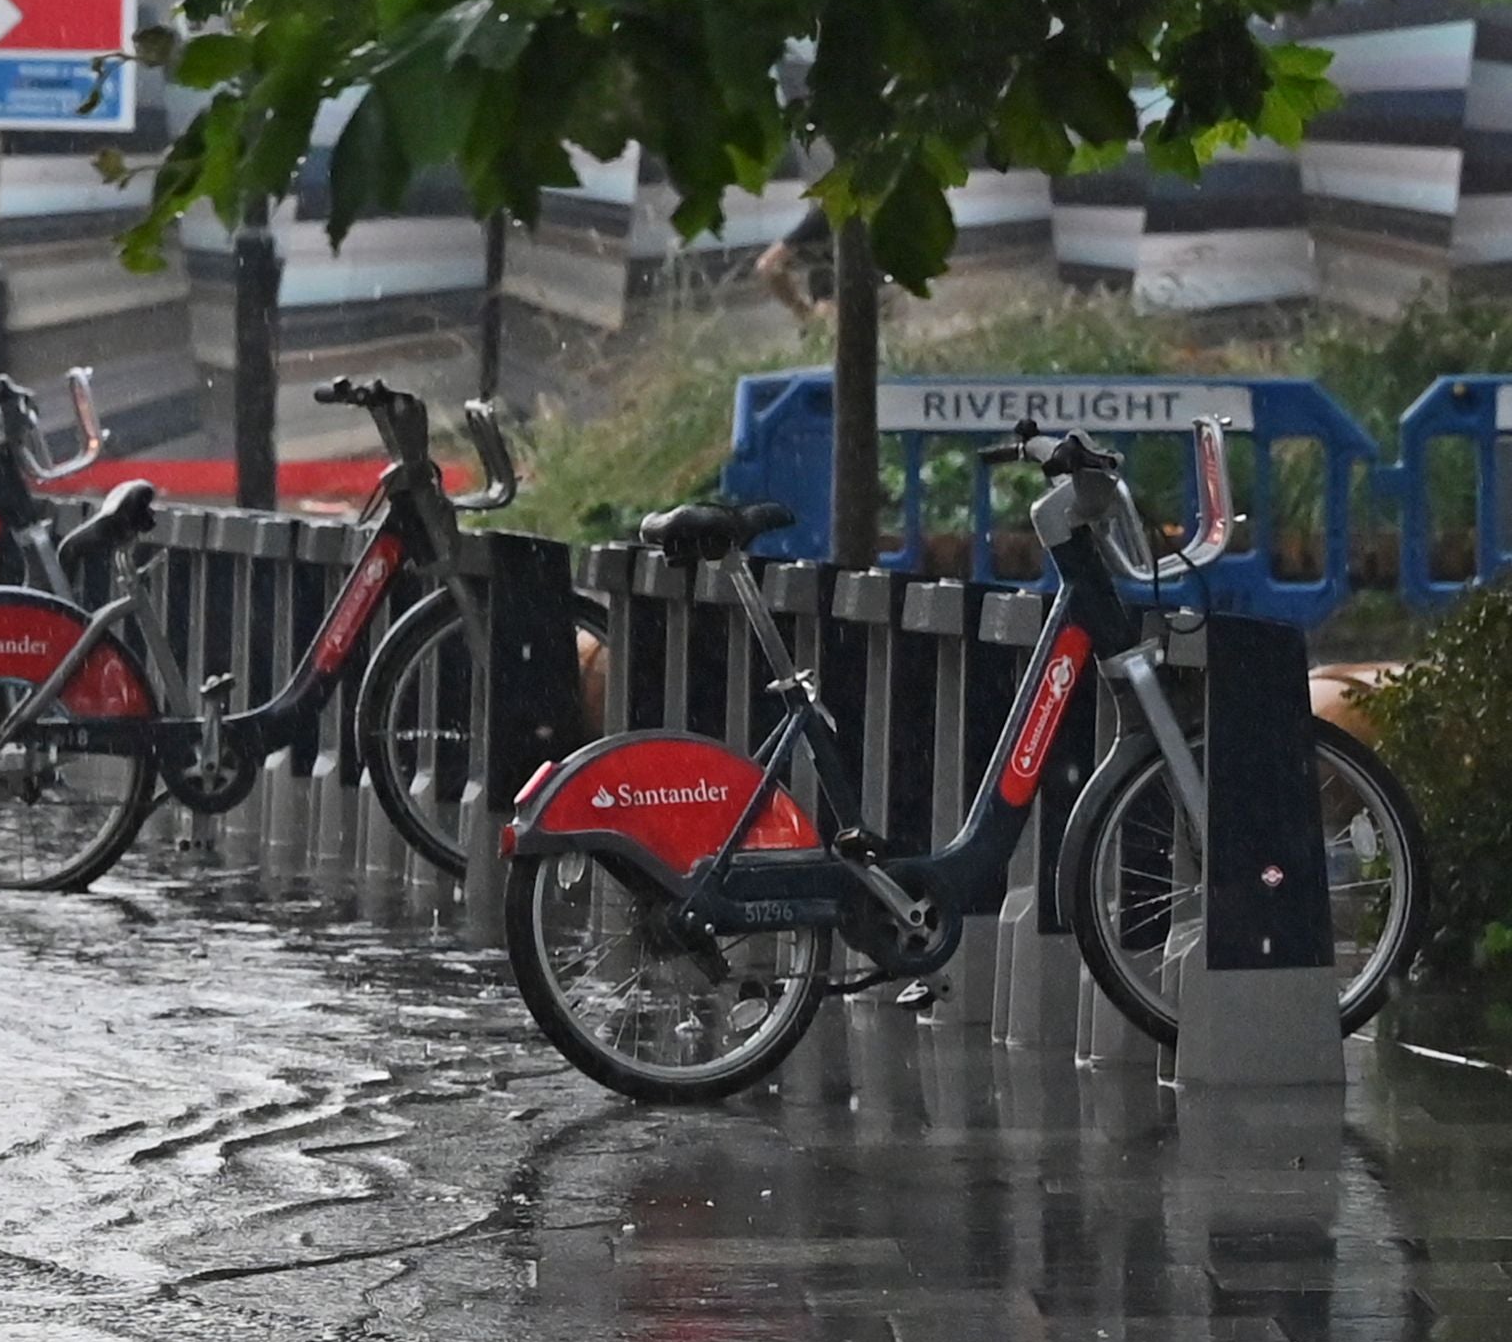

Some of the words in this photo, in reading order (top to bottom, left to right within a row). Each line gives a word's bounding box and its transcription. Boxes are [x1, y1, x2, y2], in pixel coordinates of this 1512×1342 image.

[922, 391, 1180, 422] RIVERLIGHT
[1025, 694, 1056, 757] Santander
[617, 778, 729, 807] Santander
[744, 903, 793, 922] 51296
